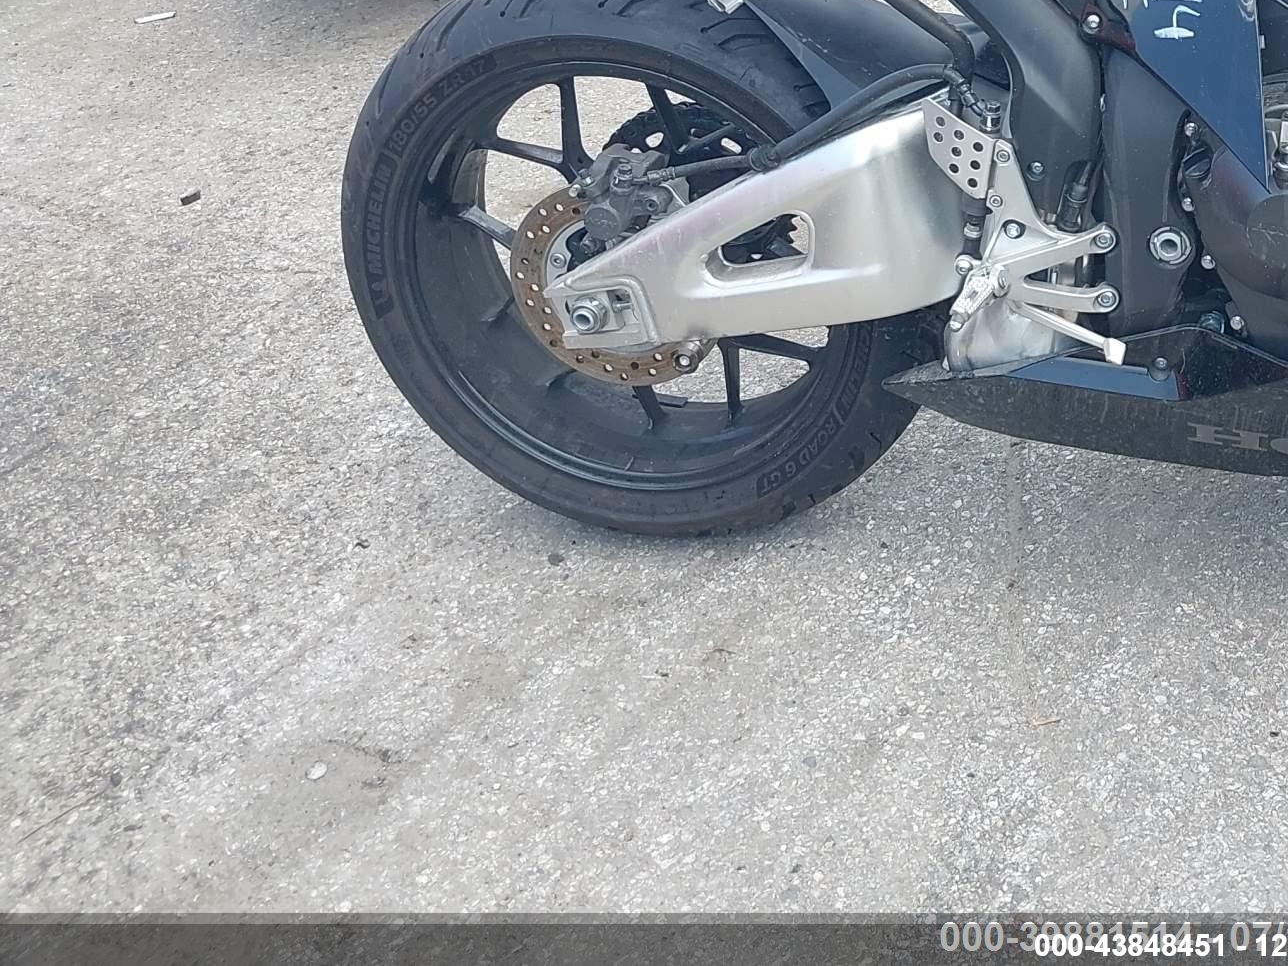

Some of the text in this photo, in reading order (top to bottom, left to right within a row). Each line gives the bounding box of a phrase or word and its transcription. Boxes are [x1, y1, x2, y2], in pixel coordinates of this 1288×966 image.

[365, 158, 393, 276] MICHELIN
[438, 72, 466, 96] ZR
[799, 418, 836, 465] ROAD
[761, 471, 782, 494] GT
